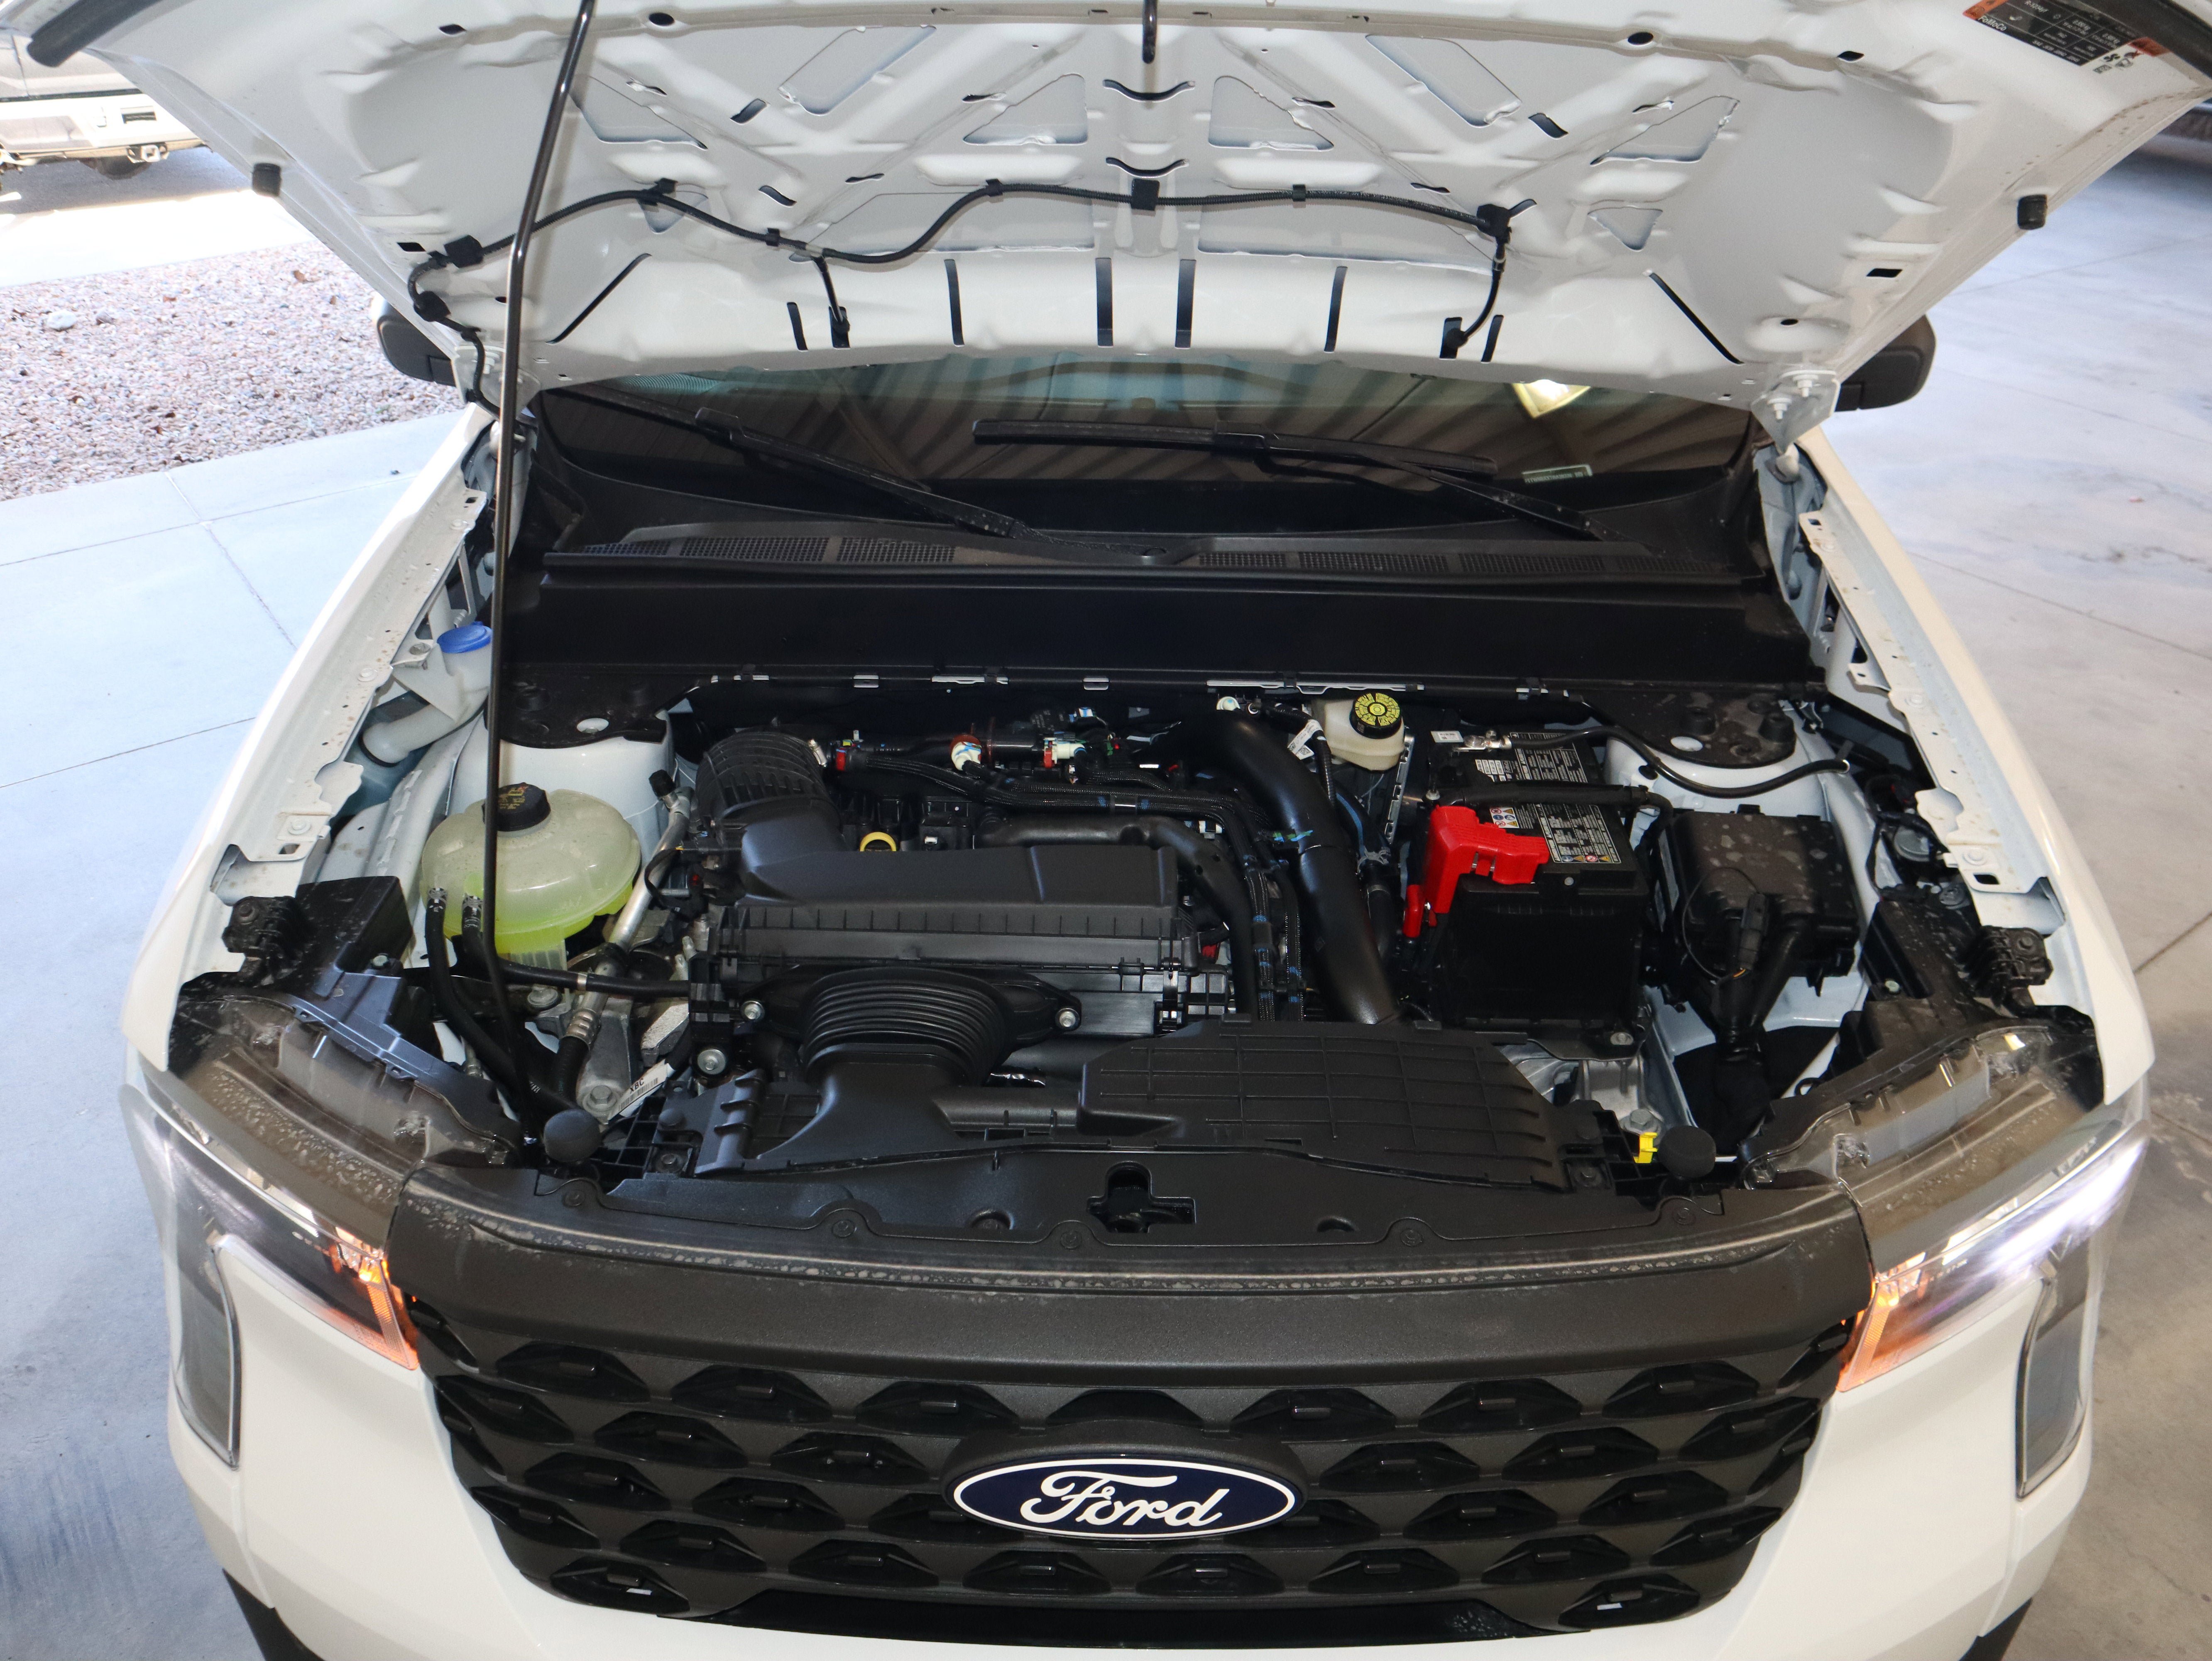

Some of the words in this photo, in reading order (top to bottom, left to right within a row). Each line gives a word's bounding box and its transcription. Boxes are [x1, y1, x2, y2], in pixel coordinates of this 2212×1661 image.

[1977, 15, 2007, 31] FoMoCo
[630, 1078, 644, 1094] XBC
[1020, 1470, 1229, 1527] Ford
